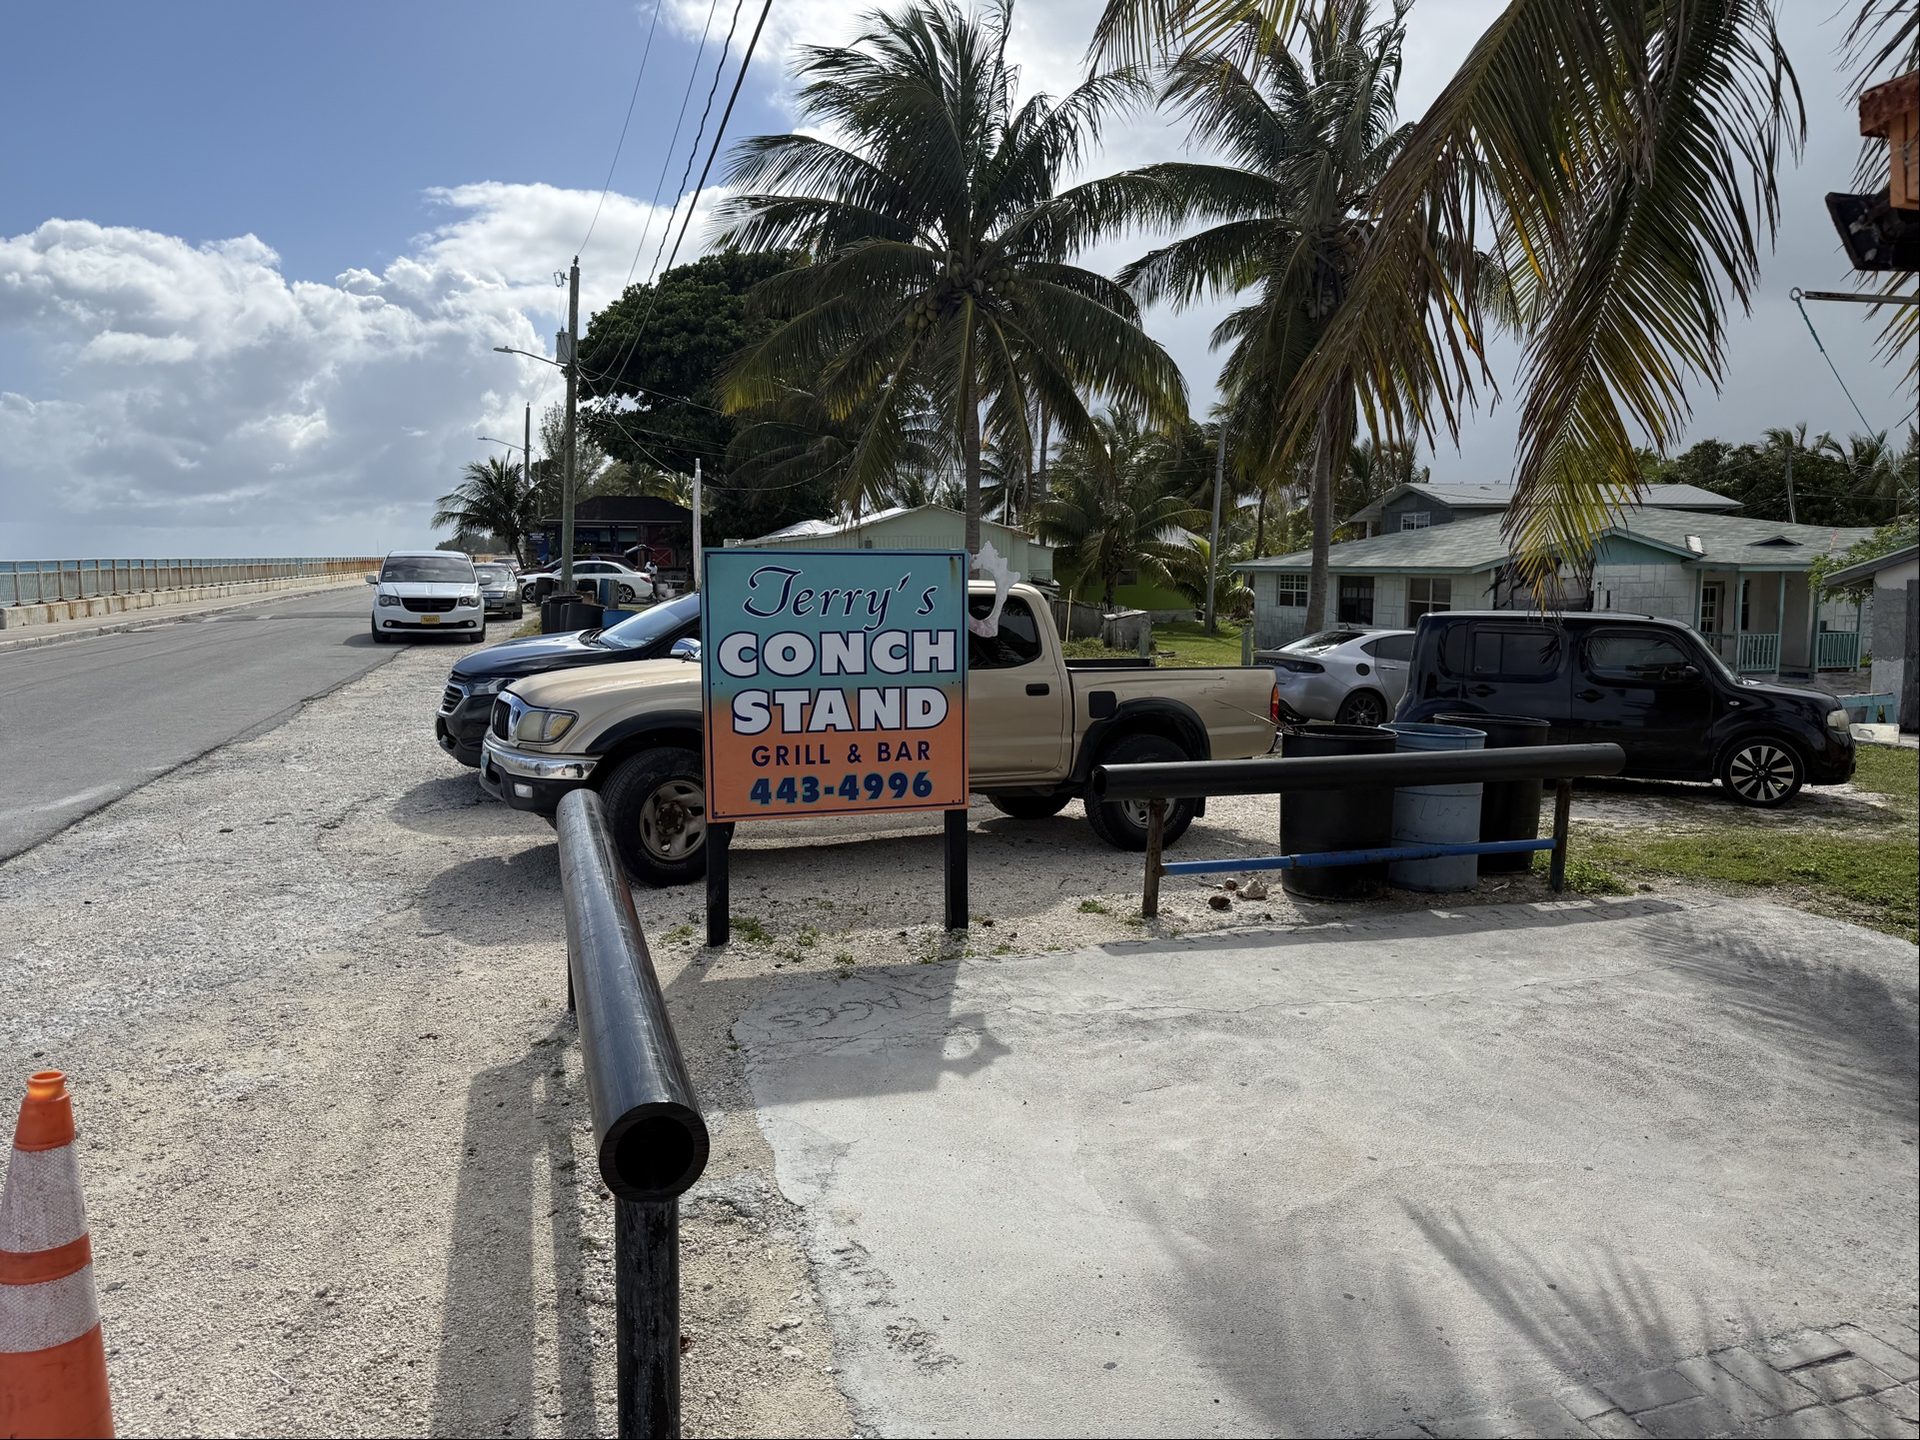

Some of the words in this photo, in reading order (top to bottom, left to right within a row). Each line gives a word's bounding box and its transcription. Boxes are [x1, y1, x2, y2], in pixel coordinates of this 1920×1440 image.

[717, 629, 957, 677] CONCH
[732, 687, 948, 736] STAND
[751, 744, 831, 767] GRILL
[847, 743, 862, 763] &
[878, 741, 931, 762] BAR
[750, 771, 933, 805] 443-4996
